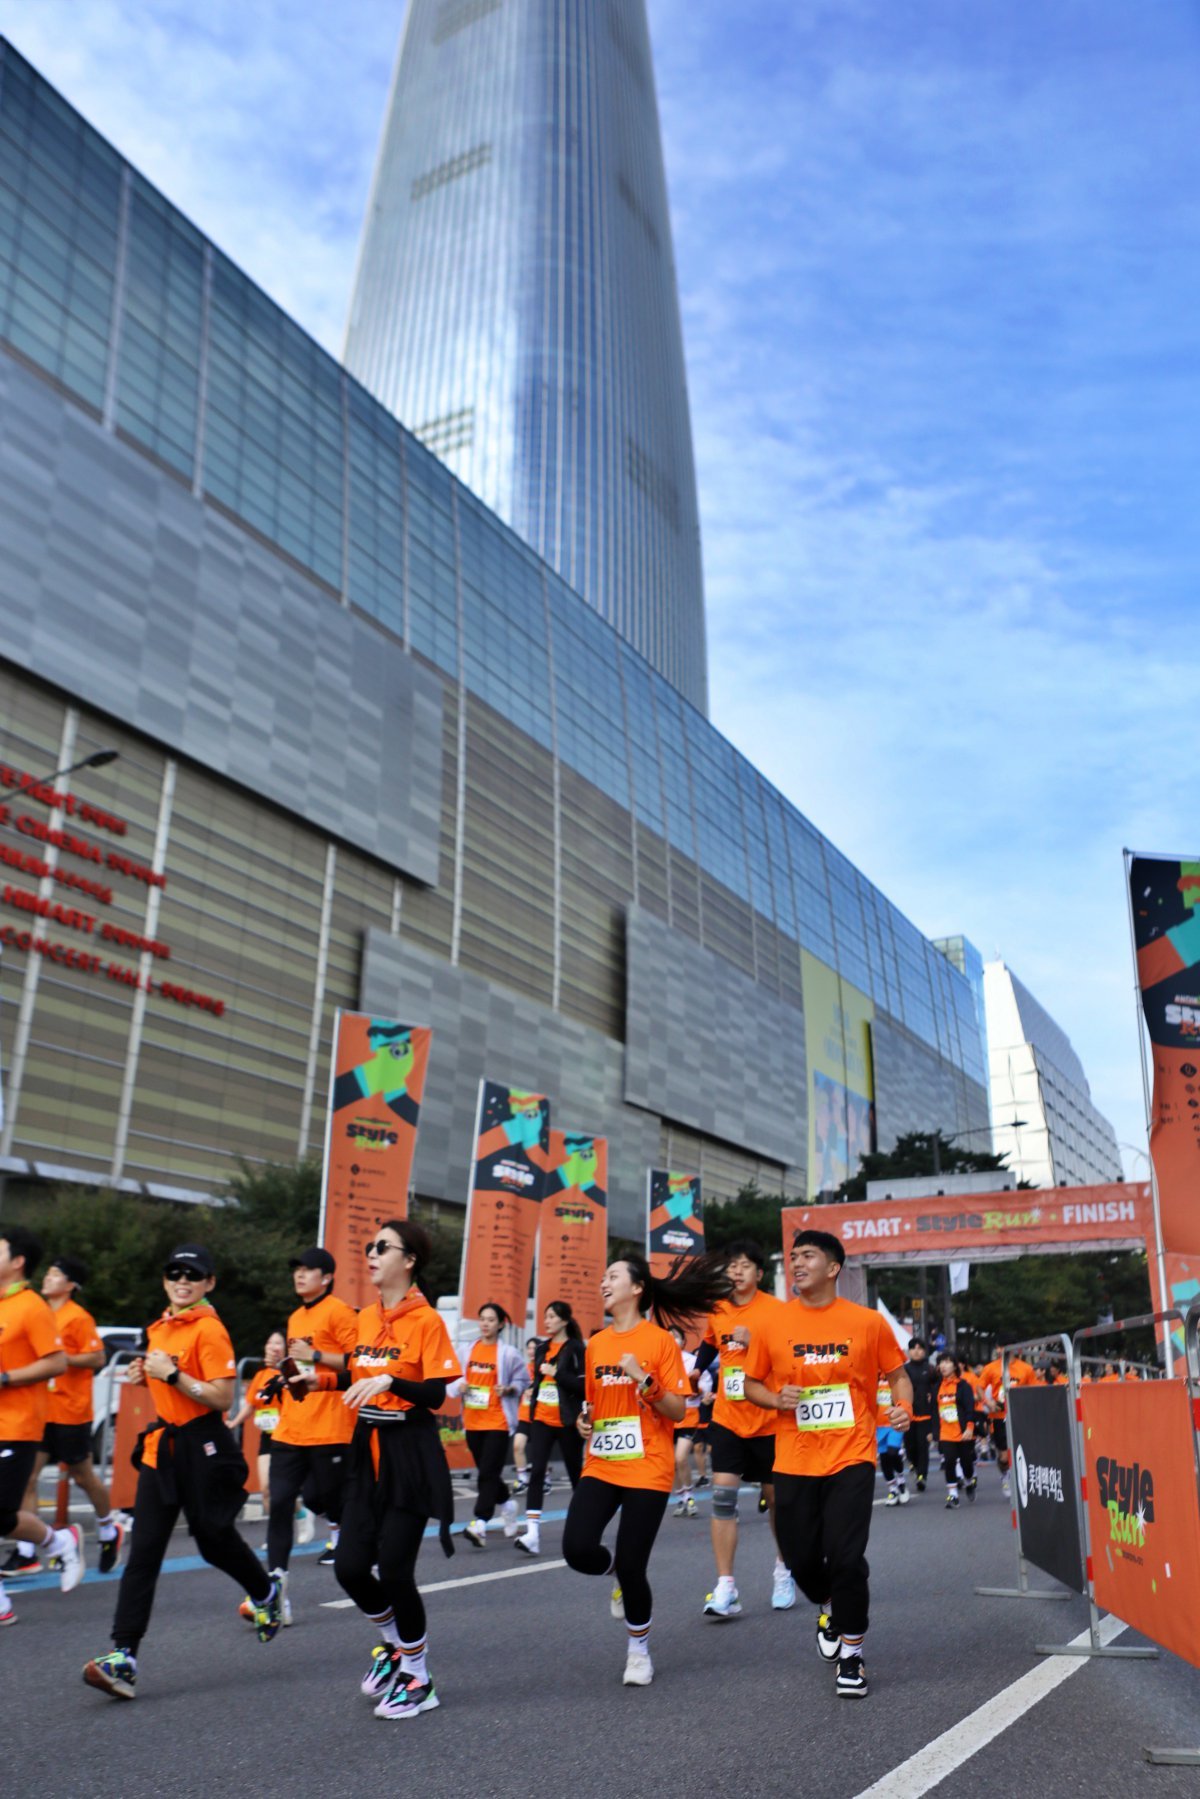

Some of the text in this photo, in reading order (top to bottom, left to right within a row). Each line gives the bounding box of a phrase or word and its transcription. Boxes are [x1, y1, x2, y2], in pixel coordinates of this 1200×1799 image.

[15, 816, 103, 865] CINEMA
[3, 884, 97, 934] HIMART
[0, 924, 102, 975] CONCERT
[842, 1217, 902, 1239] START
[1063, 1200, 1135, 1225] FINISH
[353, 1345, 401, 1360] Style
[793, 1343, 849, 1357] Style
[804, 1352, 842, 1365] Run
[801, 1401, 846, 1421] 3077
[593, 1433, 636, 1451] 4520
[1096, 1456, 1155, 1523] Style
[1107, 1500, 1145, 1549] Run
